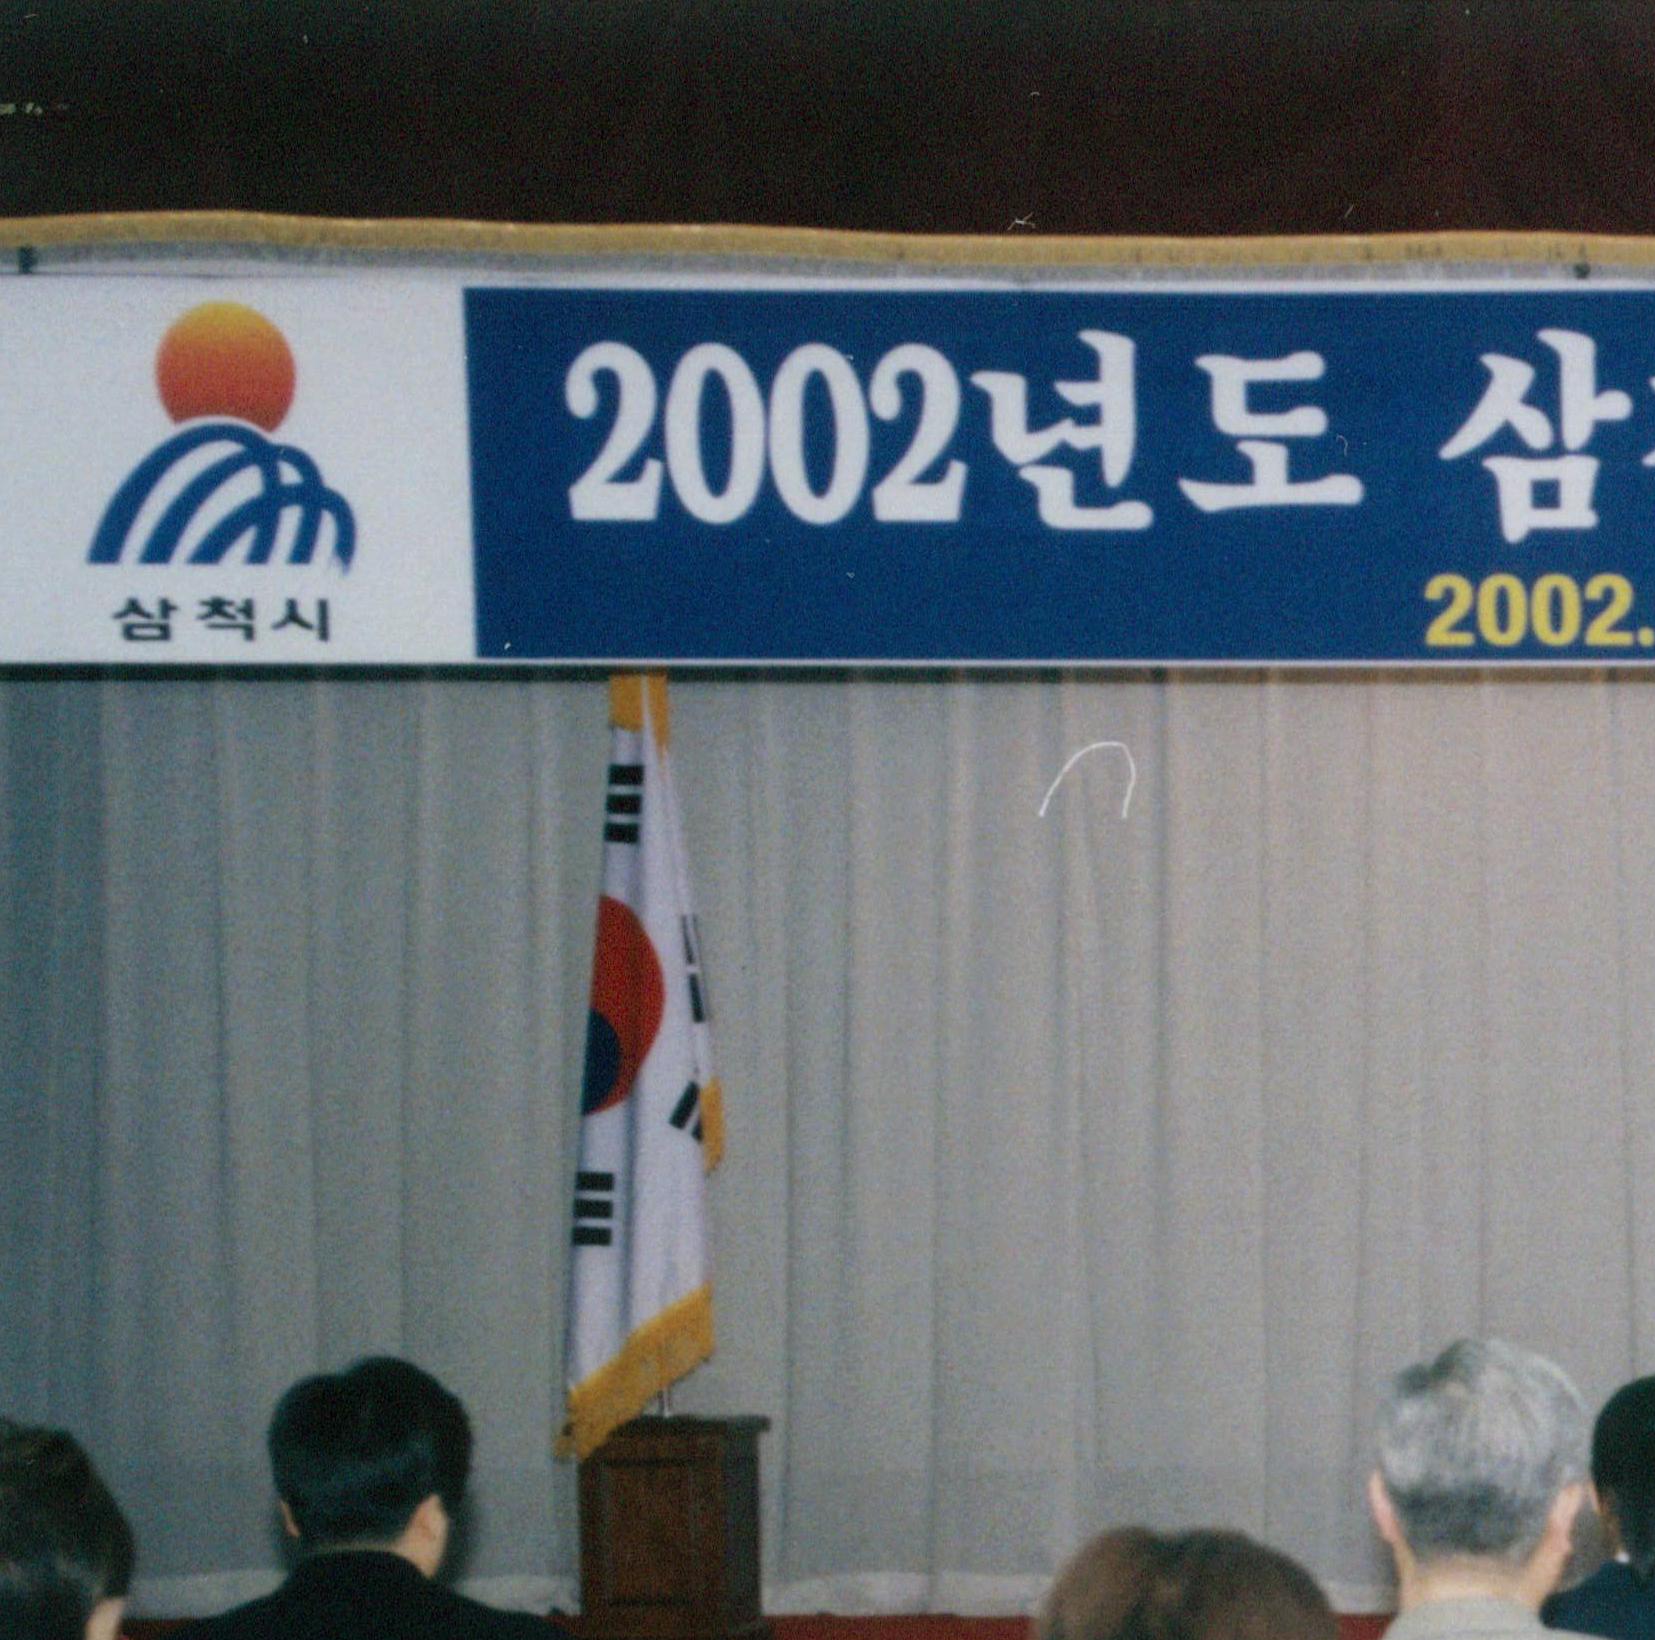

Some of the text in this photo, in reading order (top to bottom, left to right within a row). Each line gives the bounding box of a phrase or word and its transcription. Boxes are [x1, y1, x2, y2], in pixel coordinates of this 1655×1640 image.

[565, 329, 1364, 531] 2002년도
[112, 596, 331, 643] 삼척시
[1424, 573, 1655, 647] 2002.
